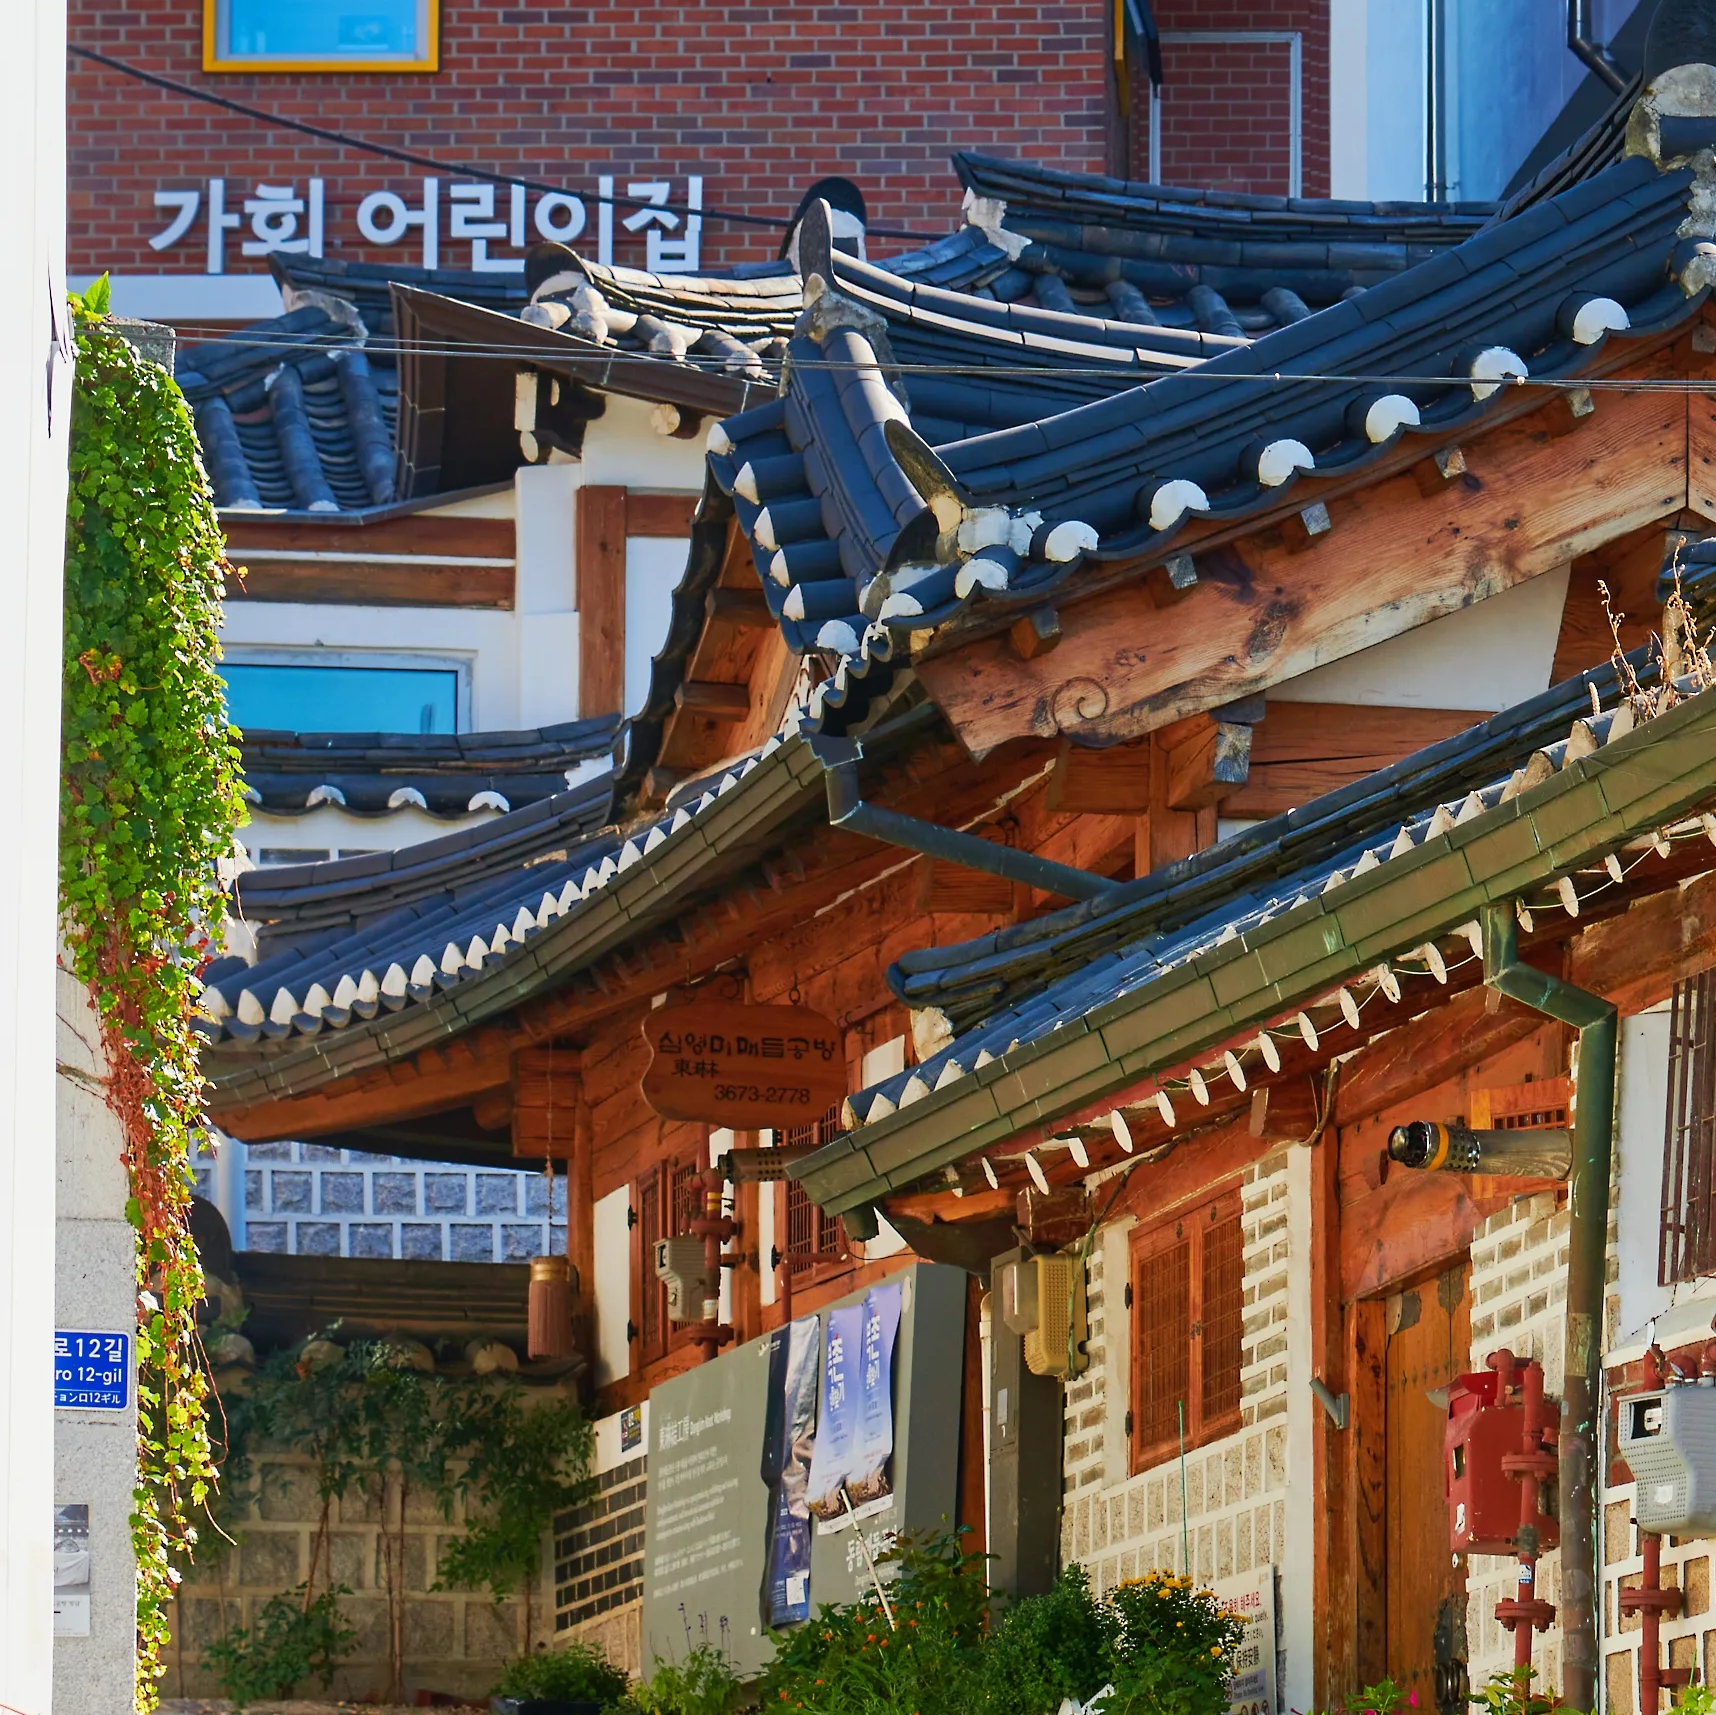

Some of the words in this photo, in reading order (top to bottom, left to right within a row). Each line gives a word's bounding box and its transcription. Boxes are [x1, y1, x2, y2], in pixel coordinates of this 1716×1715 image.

[148, 177, 325, 274] 가회
[357, 174, 703, 272] 어린이집
[713, 1084, 811, 1105] 3673-2778
[78, 1367, 122, 1386] 12-gil
